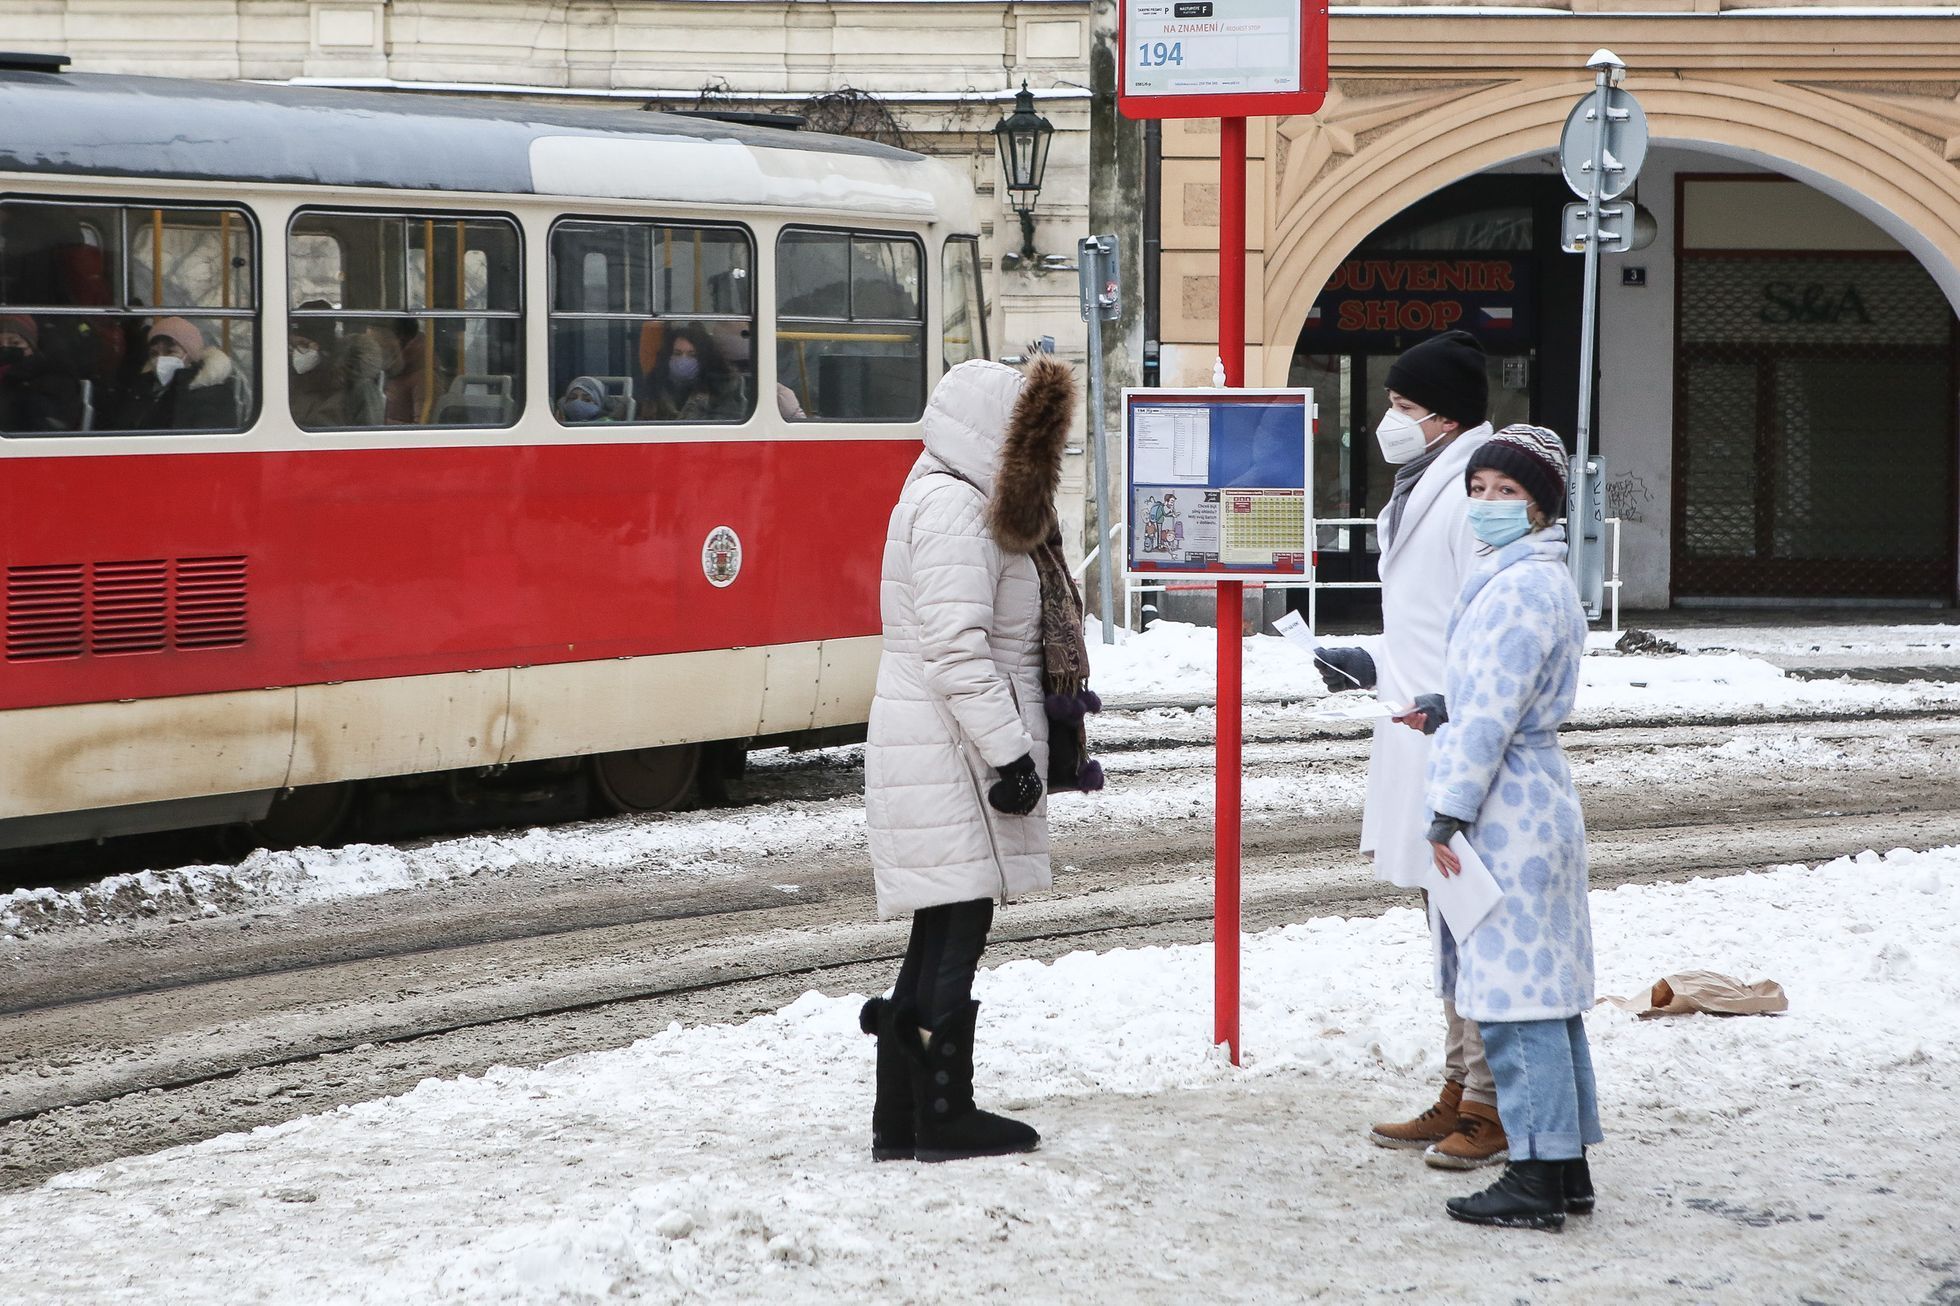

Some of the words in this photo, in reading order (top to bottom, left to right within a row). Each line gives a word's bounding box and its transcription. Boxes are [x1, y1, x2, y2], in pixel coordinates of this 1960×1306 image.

[1202, 6, 1207, 14] F
[1163, 24, 1176, 33] NA
[1177, 22, 1218, 33] ZNAMENÍ
[1139, 42, 1183, 67] 194
[1325, 260, 1515, 291] OUVENIR
[1630, 269, 1638, 281] 3
[1337, 299, 1463, 331] SHOP
